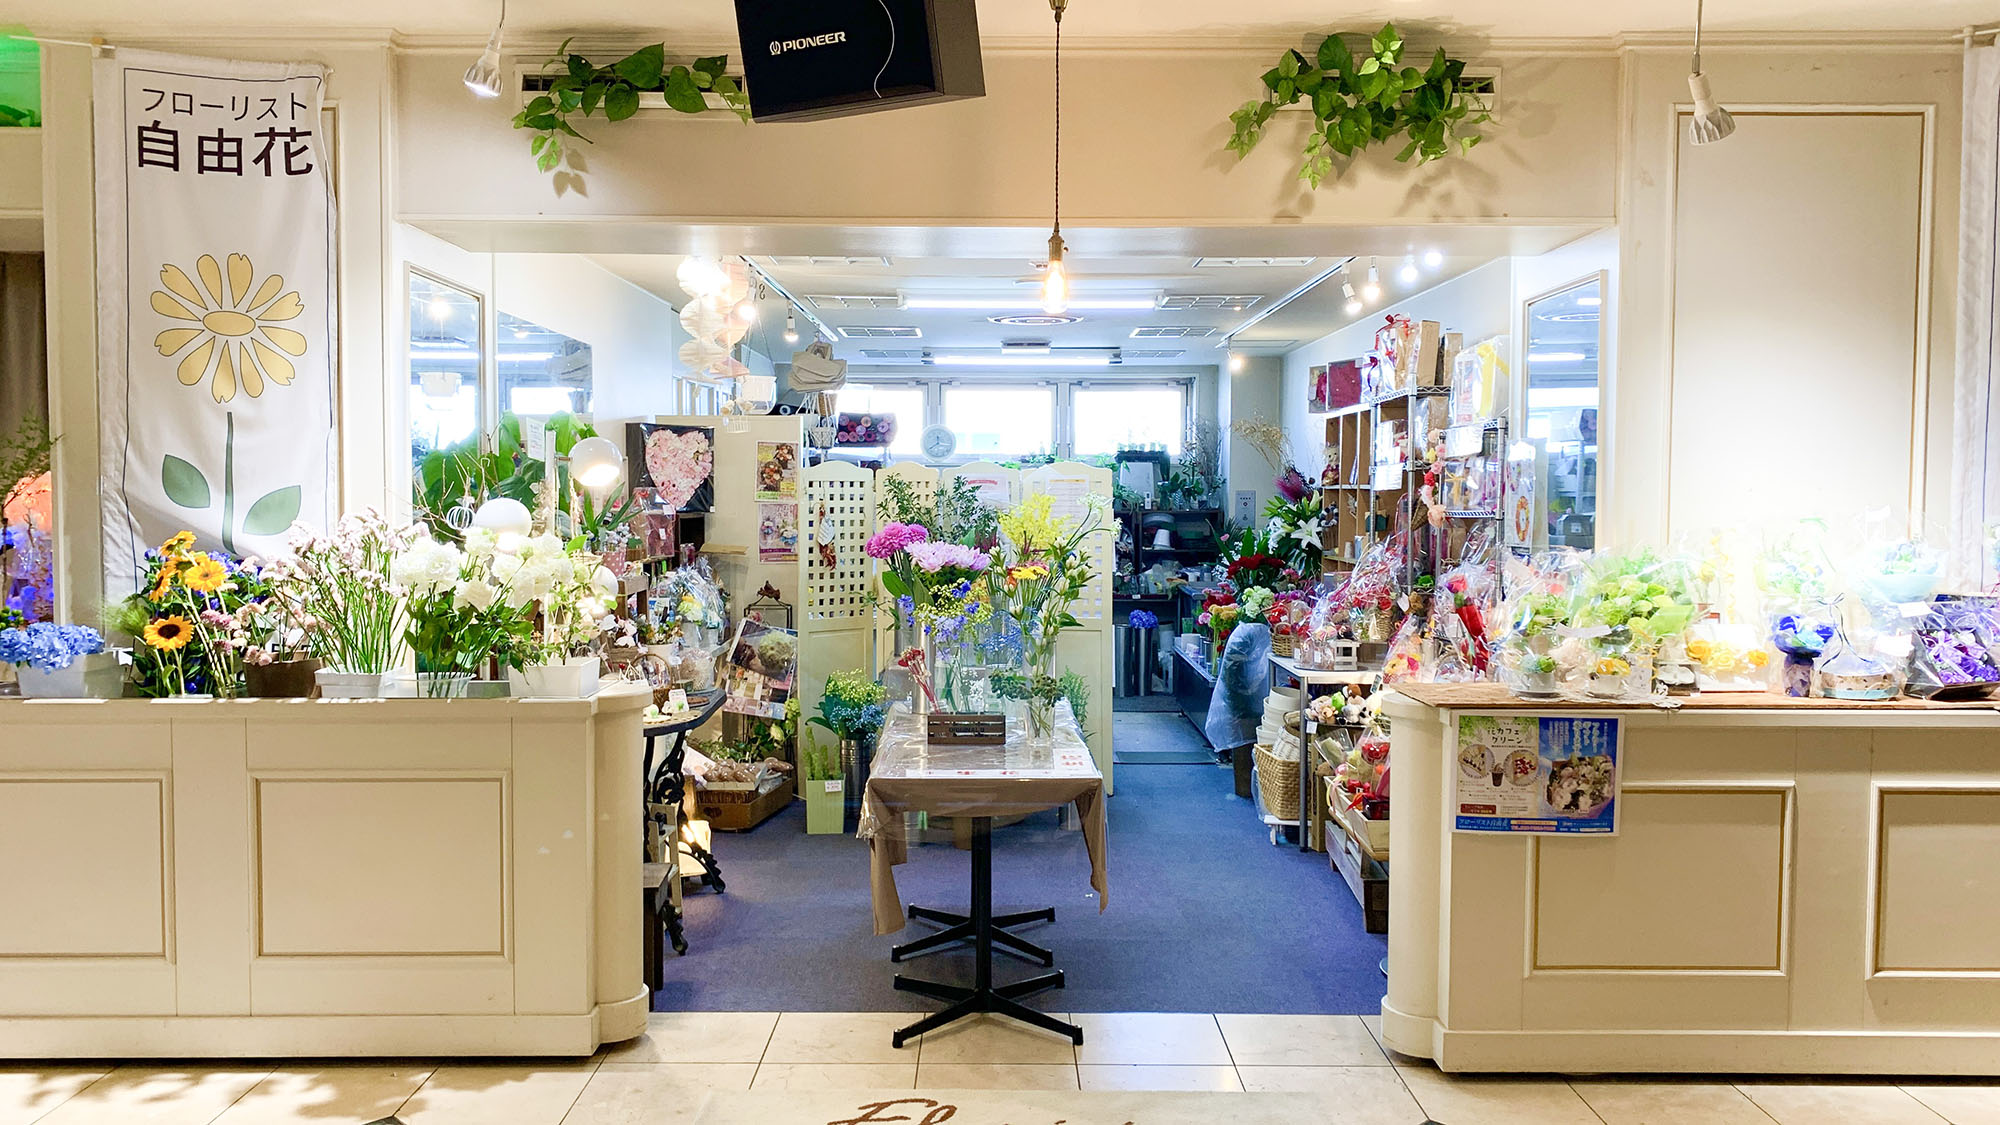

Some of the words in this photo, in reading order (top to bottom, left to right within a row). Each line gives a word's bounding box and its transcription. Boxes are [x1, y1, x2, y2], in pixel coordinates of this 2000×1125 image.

[782, 31, 846, 52] PIONEER
[142, 88, 308, 122] フローリスト
[137, 119, 313, 177] 自由花
[1491, 736, 1523, 745] グリーン
